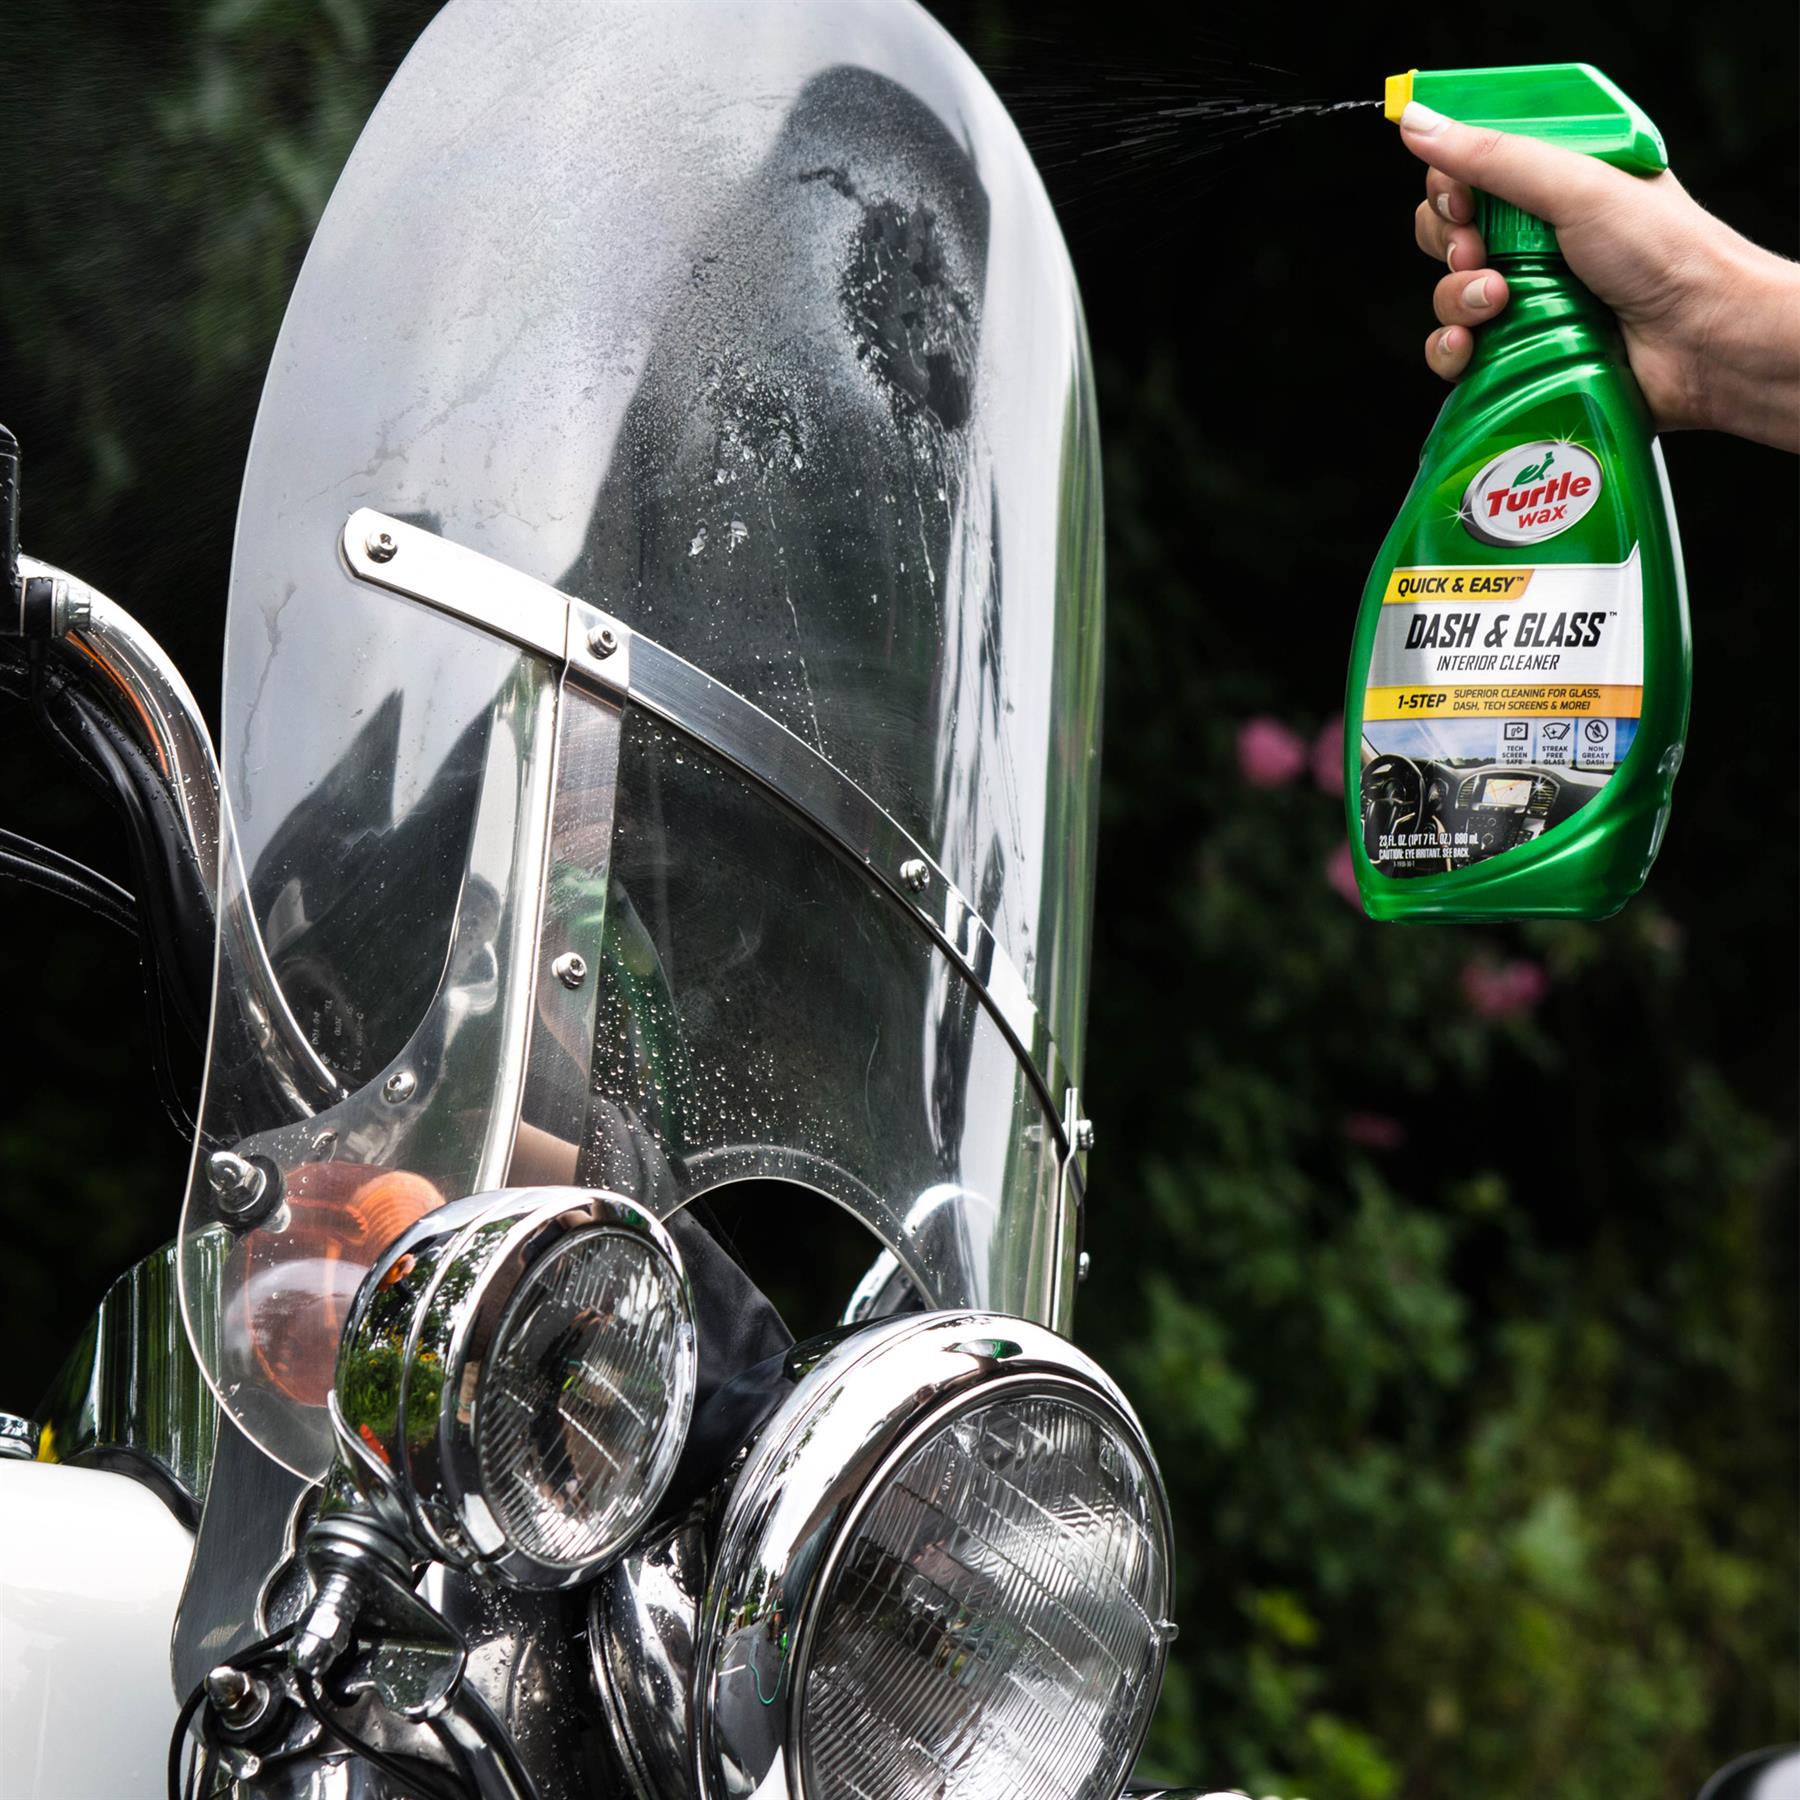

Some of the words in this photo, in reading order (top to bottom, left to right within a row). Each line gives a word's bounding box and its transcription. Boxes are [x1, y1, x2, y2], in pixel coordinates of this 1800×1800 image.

[1486, 471, 1591, 518] Turtle
[1518, 503, 1567, 529] wax
[1398, 578, 1446, 597] QUICK
[1451, 577, 1464, 592] &
[1405, 613, 1481, 649] DASH
[1484, 614, 1510, 648] &
[1436, 655, 1497, 671] INTERIOR
[1499, 654, 1560, 671] CLEANER
[1398, 694, 1447, 710] 1-STEP
[1453, 689, 1499, 699] SUPERIOR
[1501, 688, 1545, 699] CLEANING
[1547, 688, 1566, 698] FOR
[1568, 689, 1601, 700] GLASS,
[1453, 701, 1480, 711] DASH,
[1483, 701, 1505, 710] TECH
[1507, 700, 1549, 710] SCREENS
[1550, 700, 1558, 710] &
[1559, 700, 1591, 710] MORE!
[1405, 848, 1415, 859] EYE
[1442, 847, 1452, 858] SEE
